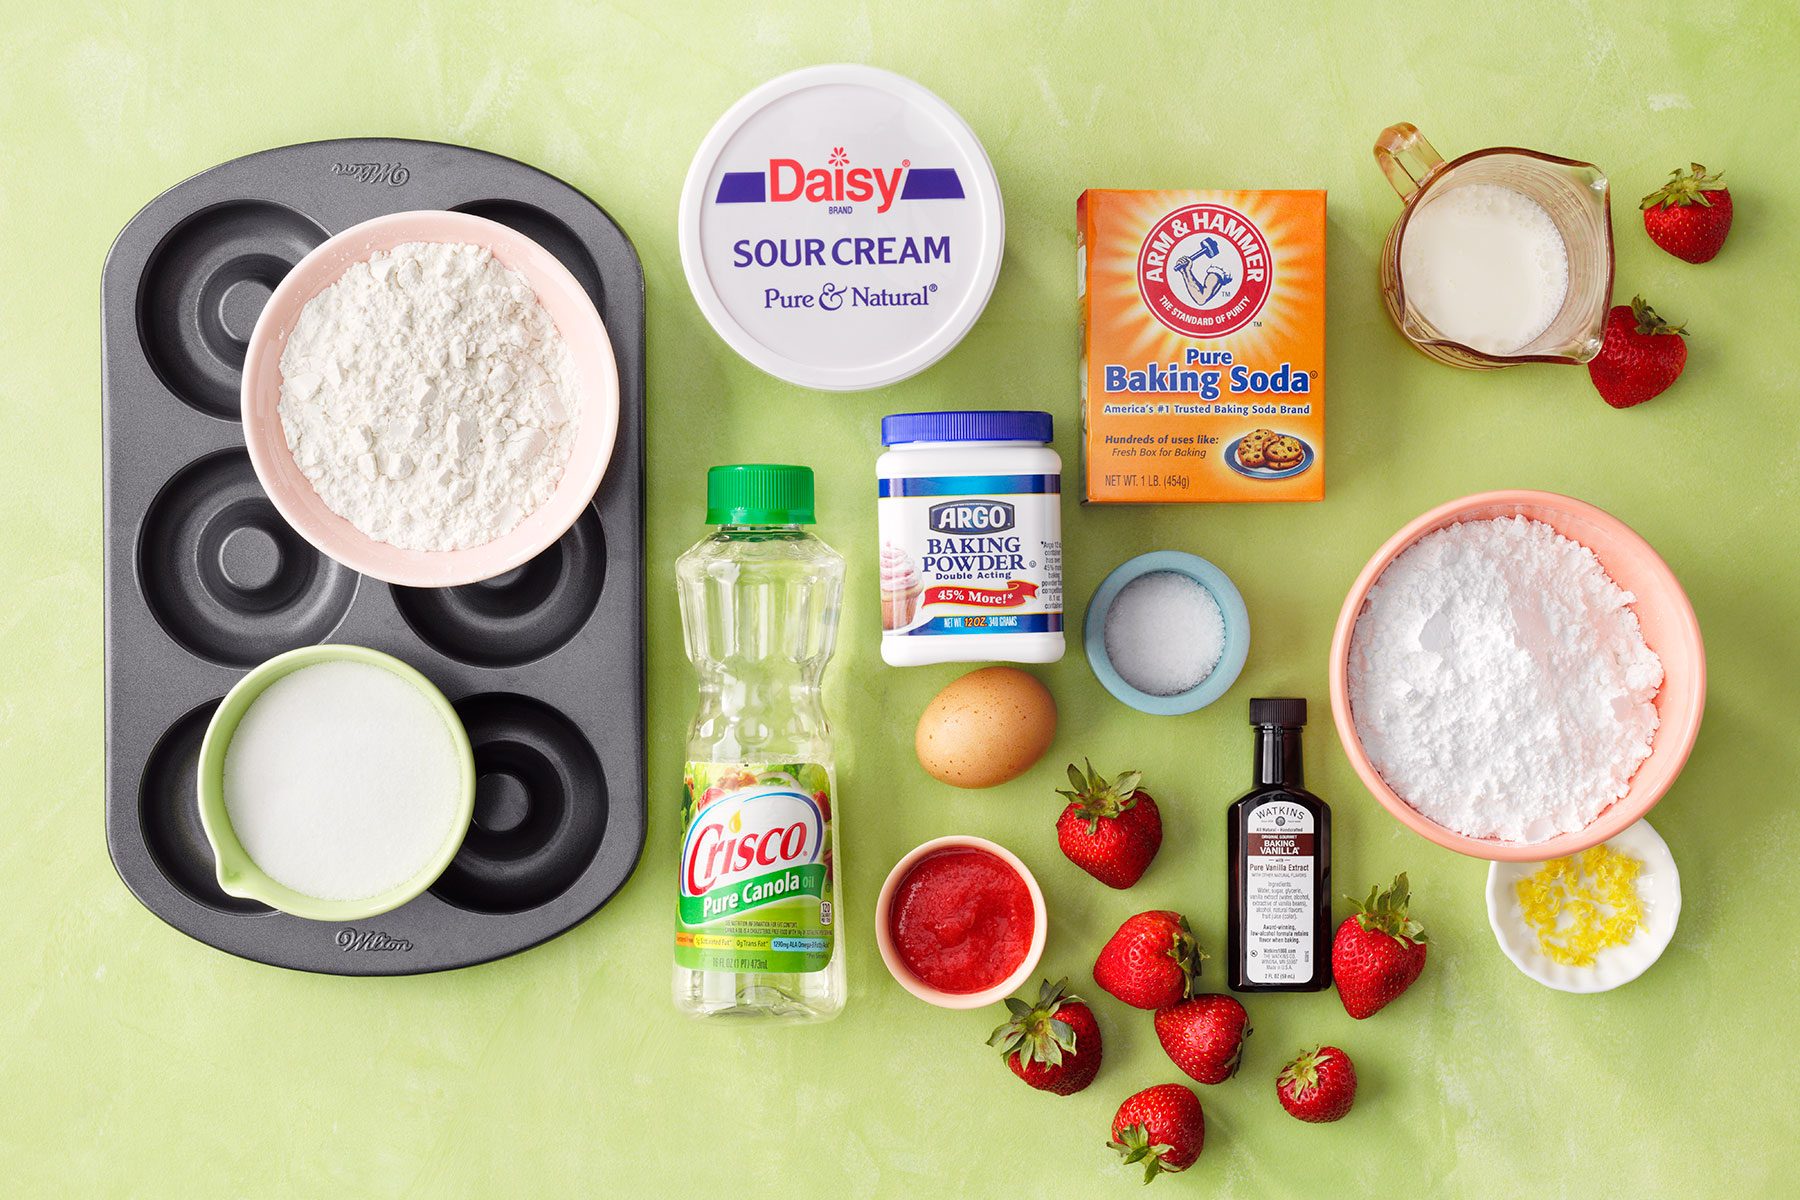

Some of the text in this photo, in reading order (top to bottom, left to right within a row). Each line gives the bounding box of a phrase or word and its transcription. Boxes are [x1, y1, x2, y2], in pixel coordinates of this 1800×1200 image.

[332, 162, 410, 187] Wilton
[769, 148, 903, 214] Daisy
[828, 206, 853, 215] BRAND
[733, 235, 951, 268] SOUR CREAM
[1146, 231, 1175, 283] ARM
[1171, 219, 1191, 238] &
[1192, 212, 1264, 283] HAMMER
[764, 282, 929, 311] Pure & Natural
[1159, 295, 1251, 326] THE STANDARD OF PURITY
[1186, 348, 1232, 365] Pure
[1105, 362, 1309, 400] Baking Soda
[1104, 404, 1310, 416] America's #1 Trusted Baking Soda Brand
[1105, 434, 1155, 444] Hundreds
[1157, 434, 1169, 444] of
[1197, 434, 1219, 444] like:
[1112, 447, 1206, 460] Fresh Box for Baking
[1105, 475, 1190, 489] NET WT. 1 LB. (454g)
[938, 505, 1007, 529] ARGO
[927, 536, 1021, 555] BAKING
[922, 554, 1027, 573] POWDER
[935, 571, 1012, 580] Double Acting
[937, 589, 965, 601] 45%
[944, 617, 953, 628] NET
[999, 616, 1017, 627] GRAMS
[1256, 806, 1305, 820] WATKINS
[687, 821, 808, 897] Crisco
[1260, 847, 1299, 855] VANILLA
[703, 871, 815, 918] Pure Canola Oil
[822, 903, 830, 913] 120
[335, 927, 414, 952] Wilton
